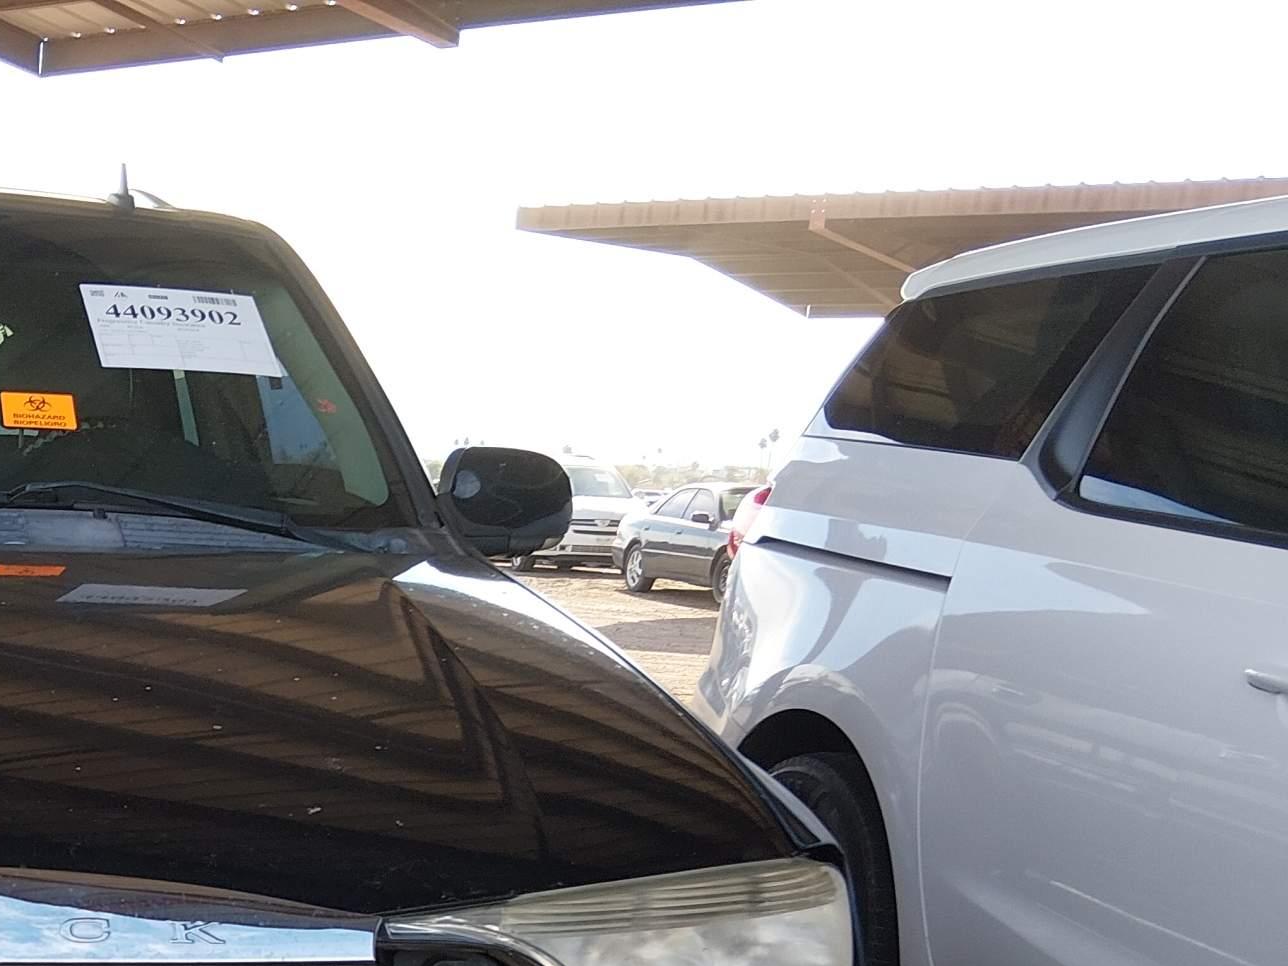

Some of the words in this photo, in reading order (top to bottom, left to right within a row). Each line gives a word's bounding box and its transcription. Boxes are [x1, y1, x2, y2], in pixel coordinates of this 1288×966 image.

[105, 303, 242, 326] 44093902
[12, 412, 66, 420] BIOHAZARD
[13, 419, 67, 427] BIOPELIGRO
